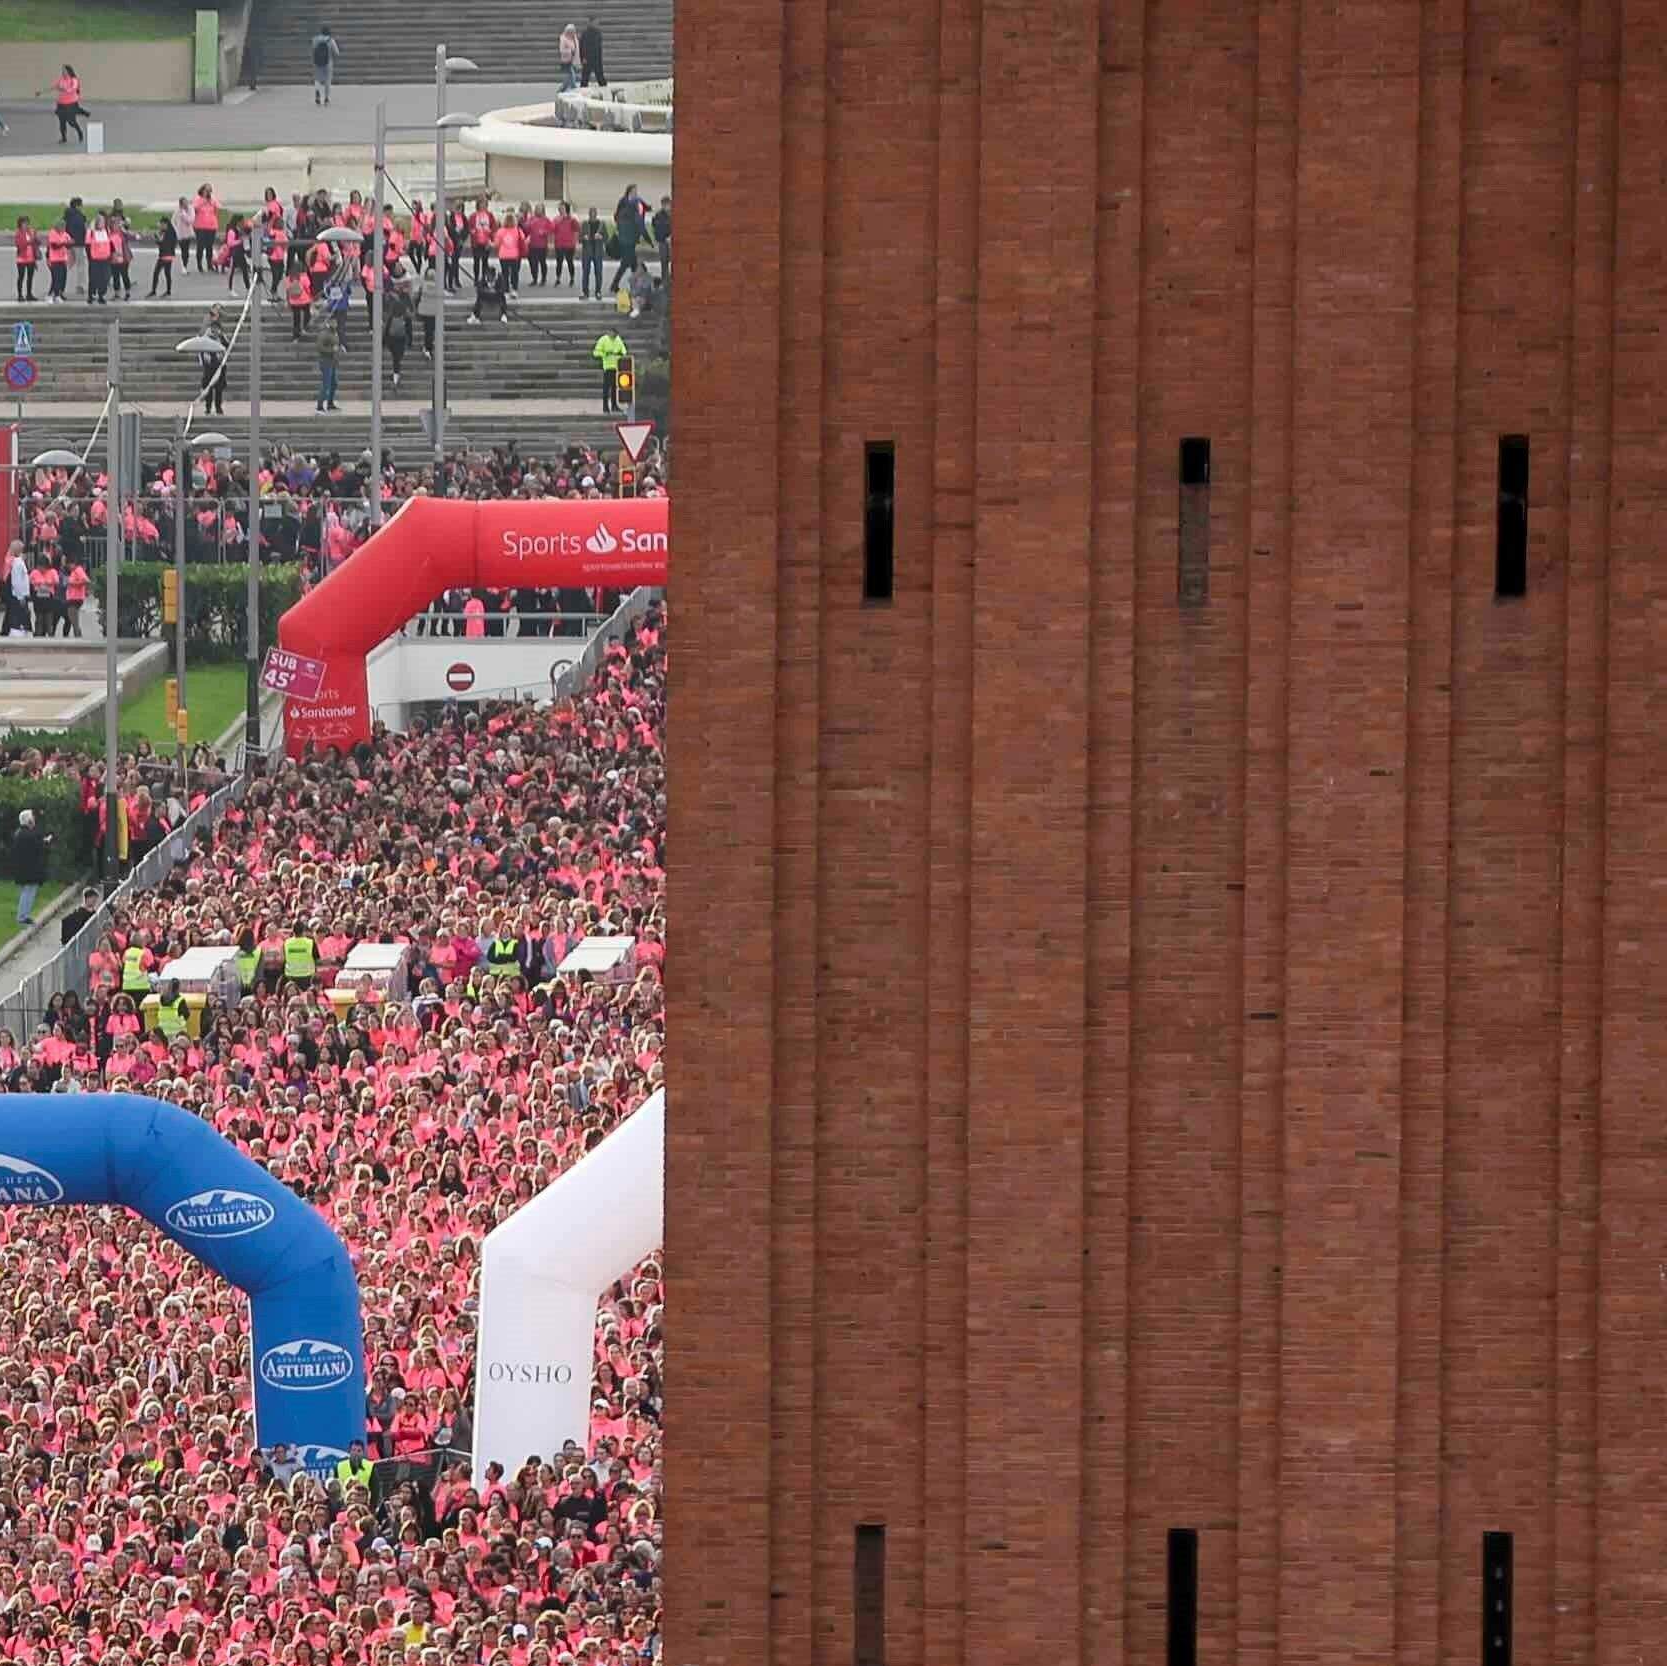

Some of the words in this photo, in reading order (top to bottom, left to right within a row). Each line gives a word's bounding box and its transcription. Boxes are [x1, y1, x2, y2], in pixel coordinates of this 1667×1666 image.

[503, 530, 582, 560] Sports
[621, 528, 668, 552] San
[269, 652, 297, 671] SUB
[265, 669, 296, 688] 45'
[301, 705, 356, 719] Santander
[175, 1207, 267, 1228] ASTURIANA
[267, 1359, 347, 1377] ASTURIANA
[489, 1362, 573, 1385] OYSHO
